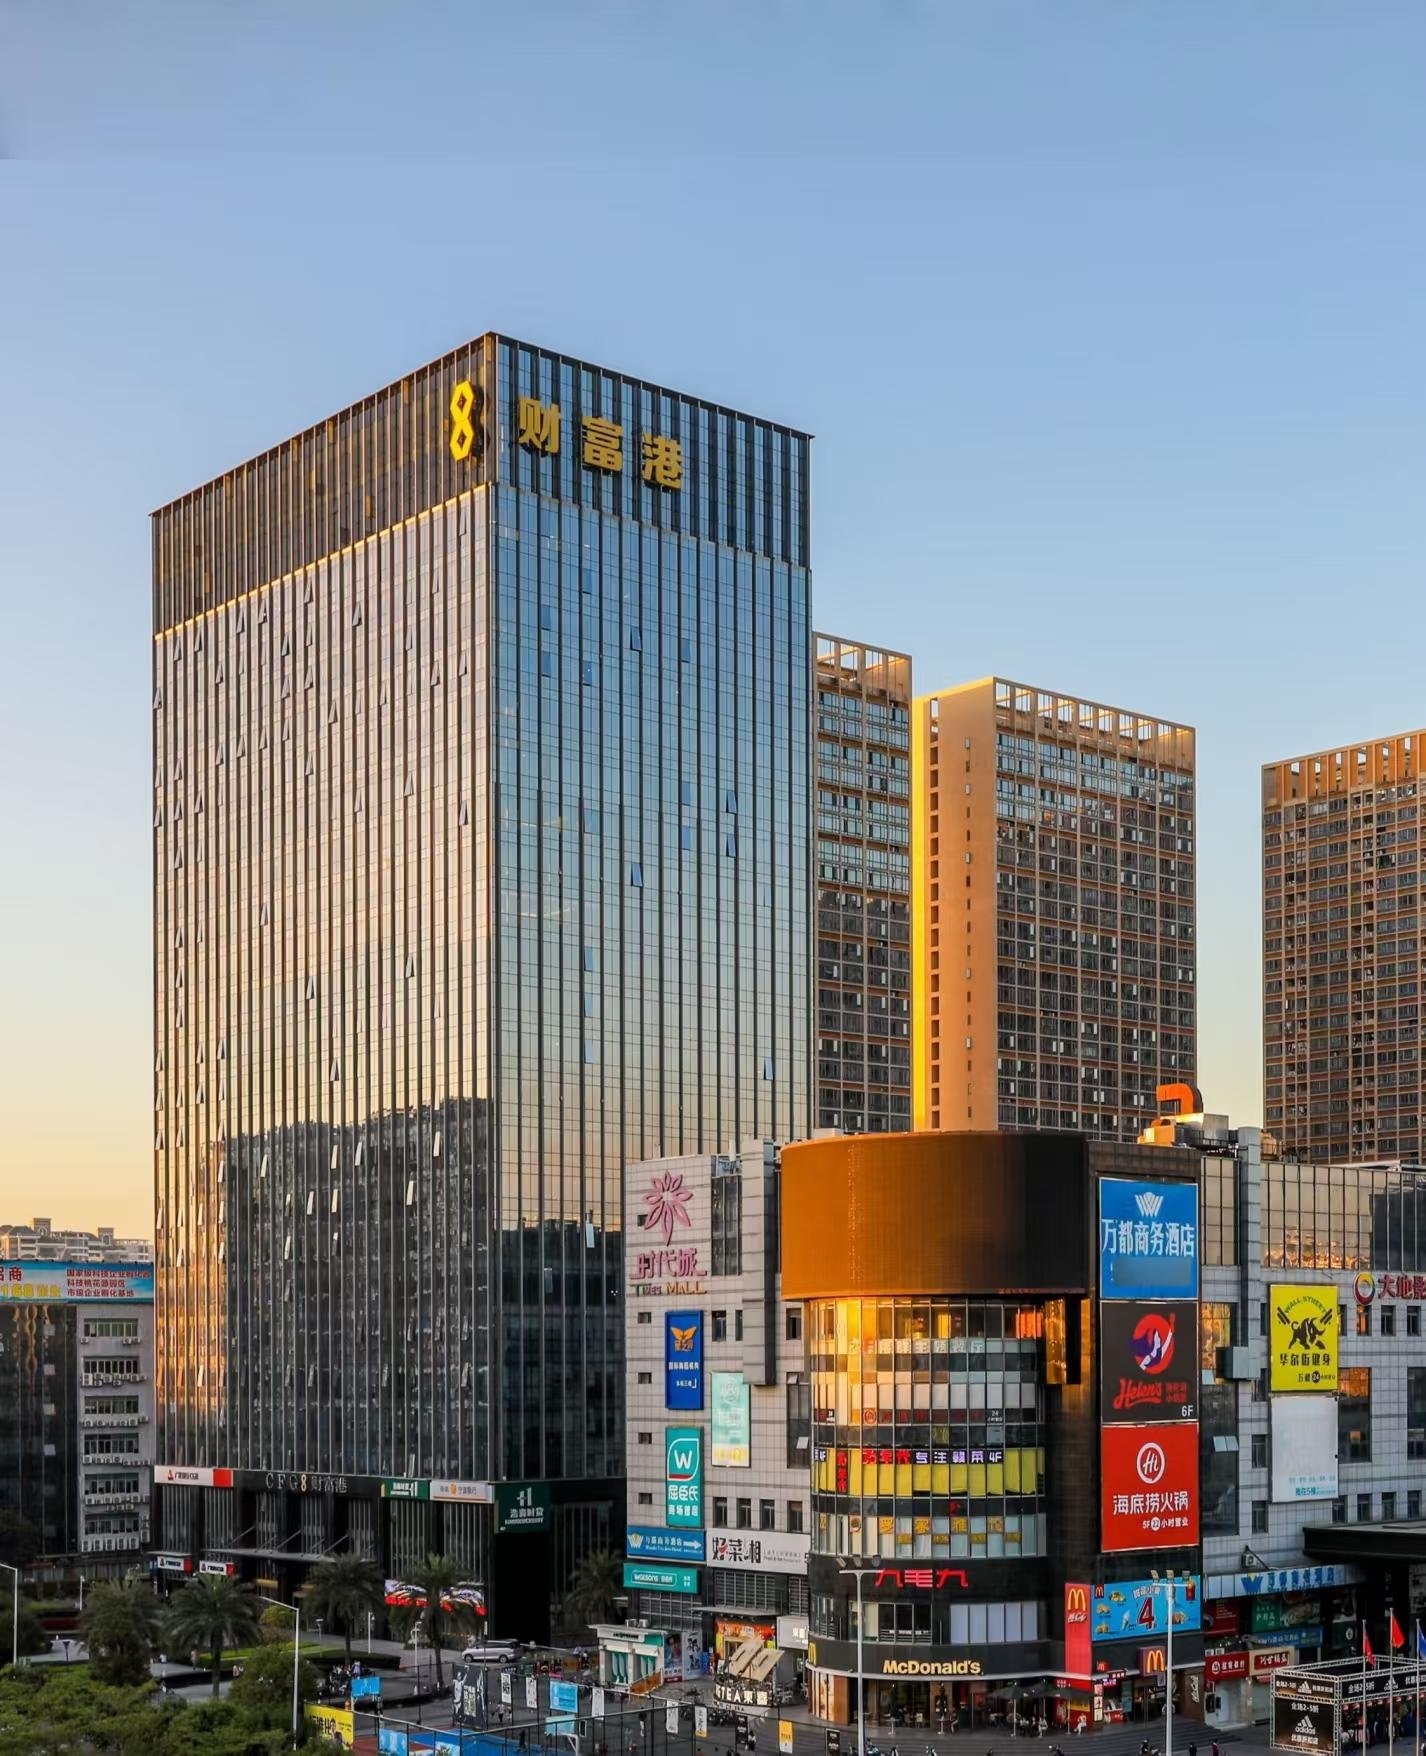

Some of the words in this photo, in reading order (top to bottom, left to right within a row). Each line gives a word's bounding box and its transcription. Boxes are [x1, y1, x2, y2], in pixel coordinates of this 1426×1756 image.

[518, 397, 682, 489] 财富港
[1102, 1219, 1195, 1257] 万都商务酒店
[666, 1279, 707, 1295] MALL
[1280, 1352, 1330, 1366] 华尔街健身
[1181, 1404, 1194, 1417] 6F
[989, 1452, 1002, 1463] 4F
[668, 1484, 698, 1501] 屈臣氏
[1113, 1491, 1188, 1515] 海底捞火锅
[875, 1568, 969, 1588] 九毛九
[883, 1659, 982, 1675] McDonald's
[1295, 1726, 1316, 1735] adidas
